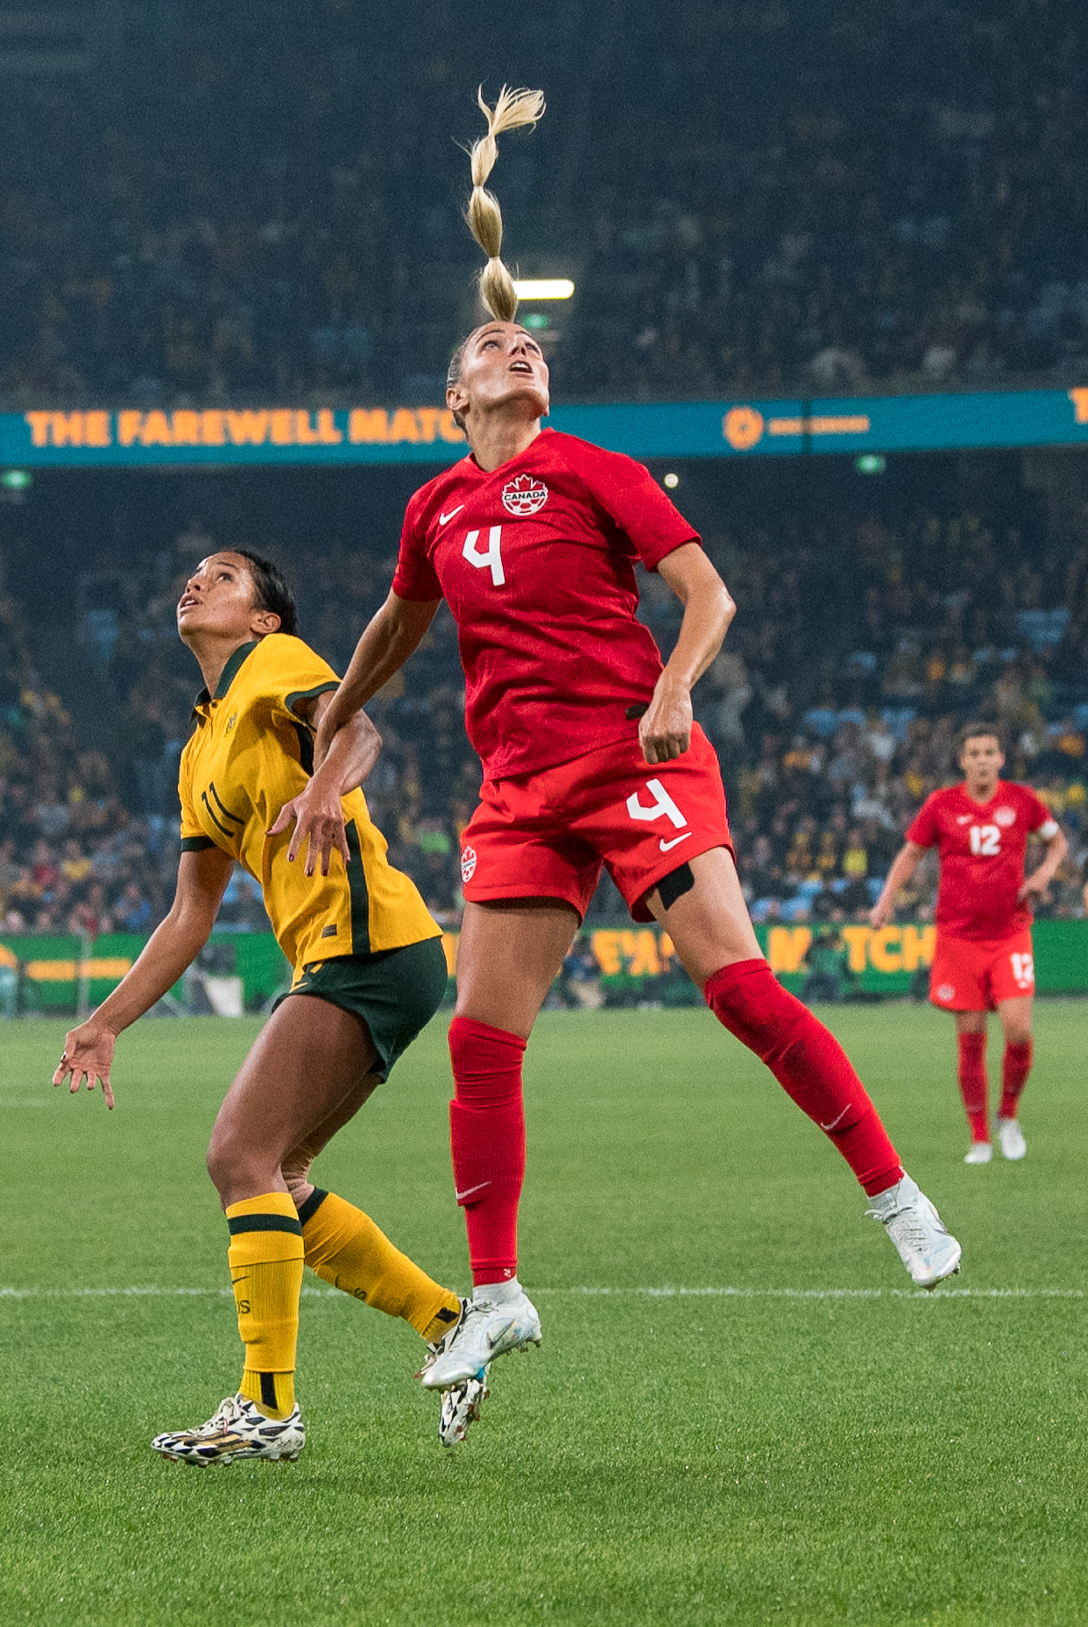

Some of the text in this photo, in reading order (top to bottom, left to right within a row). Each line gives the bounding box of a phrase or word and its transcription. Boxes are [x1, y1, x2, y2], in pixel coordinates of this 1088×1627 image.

[27, 406, 465, 446] THE FAREWELL MATC
[504, 490, 546, 501] CANADA
[462, 525, 505, 586] 4
[201, 781, 245, 838] 11
[626, 778, 688, 829] 4
[969, 825, 1001, 855] 12
[768, 925, 936, 973] MTCH
[1010, 952, 1034, 982] 12
